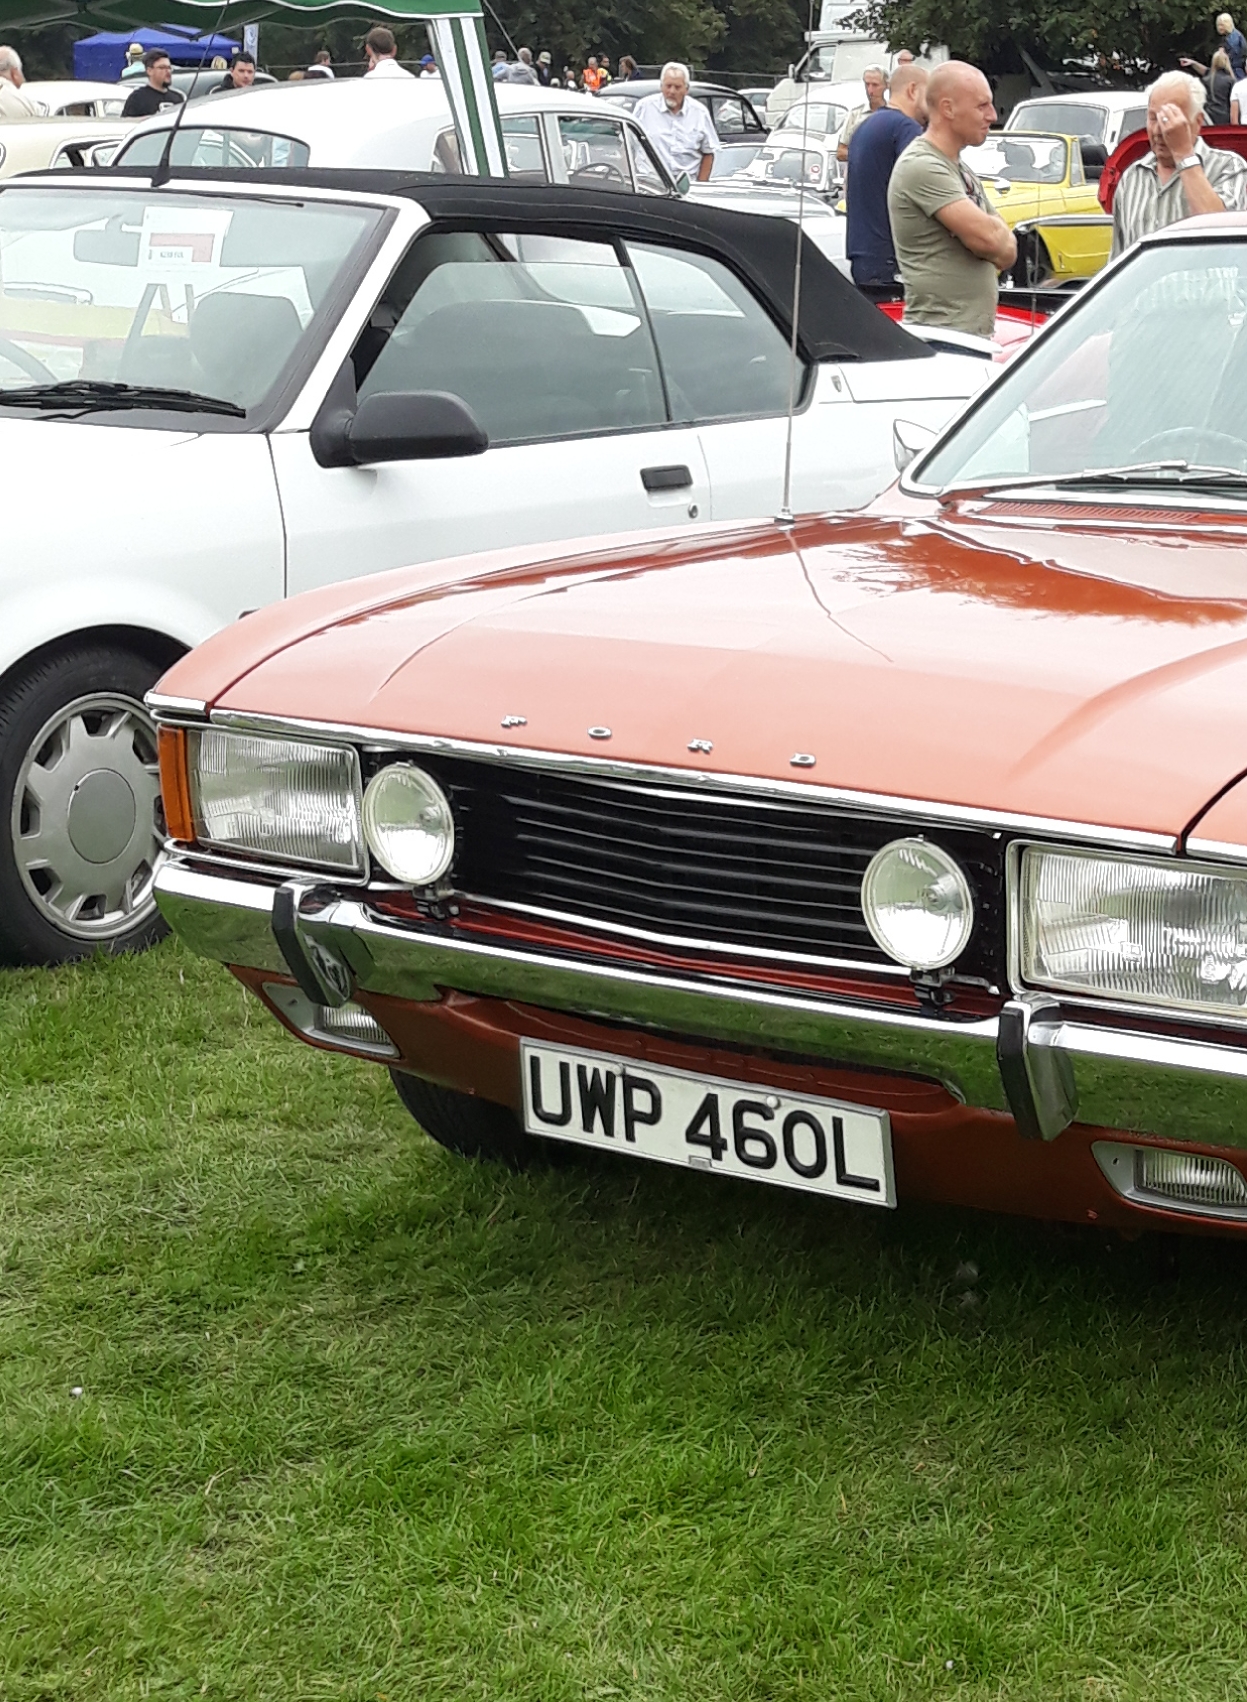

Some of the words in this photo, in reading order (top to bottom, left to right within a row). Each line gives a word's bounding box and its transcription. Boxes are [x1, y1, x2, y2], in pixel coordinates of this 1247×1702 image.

[501, 714, 816, 767] FORD
[530, 1055, 662, 1143] UWP
[685, 1092, 880, 1192] 460L
